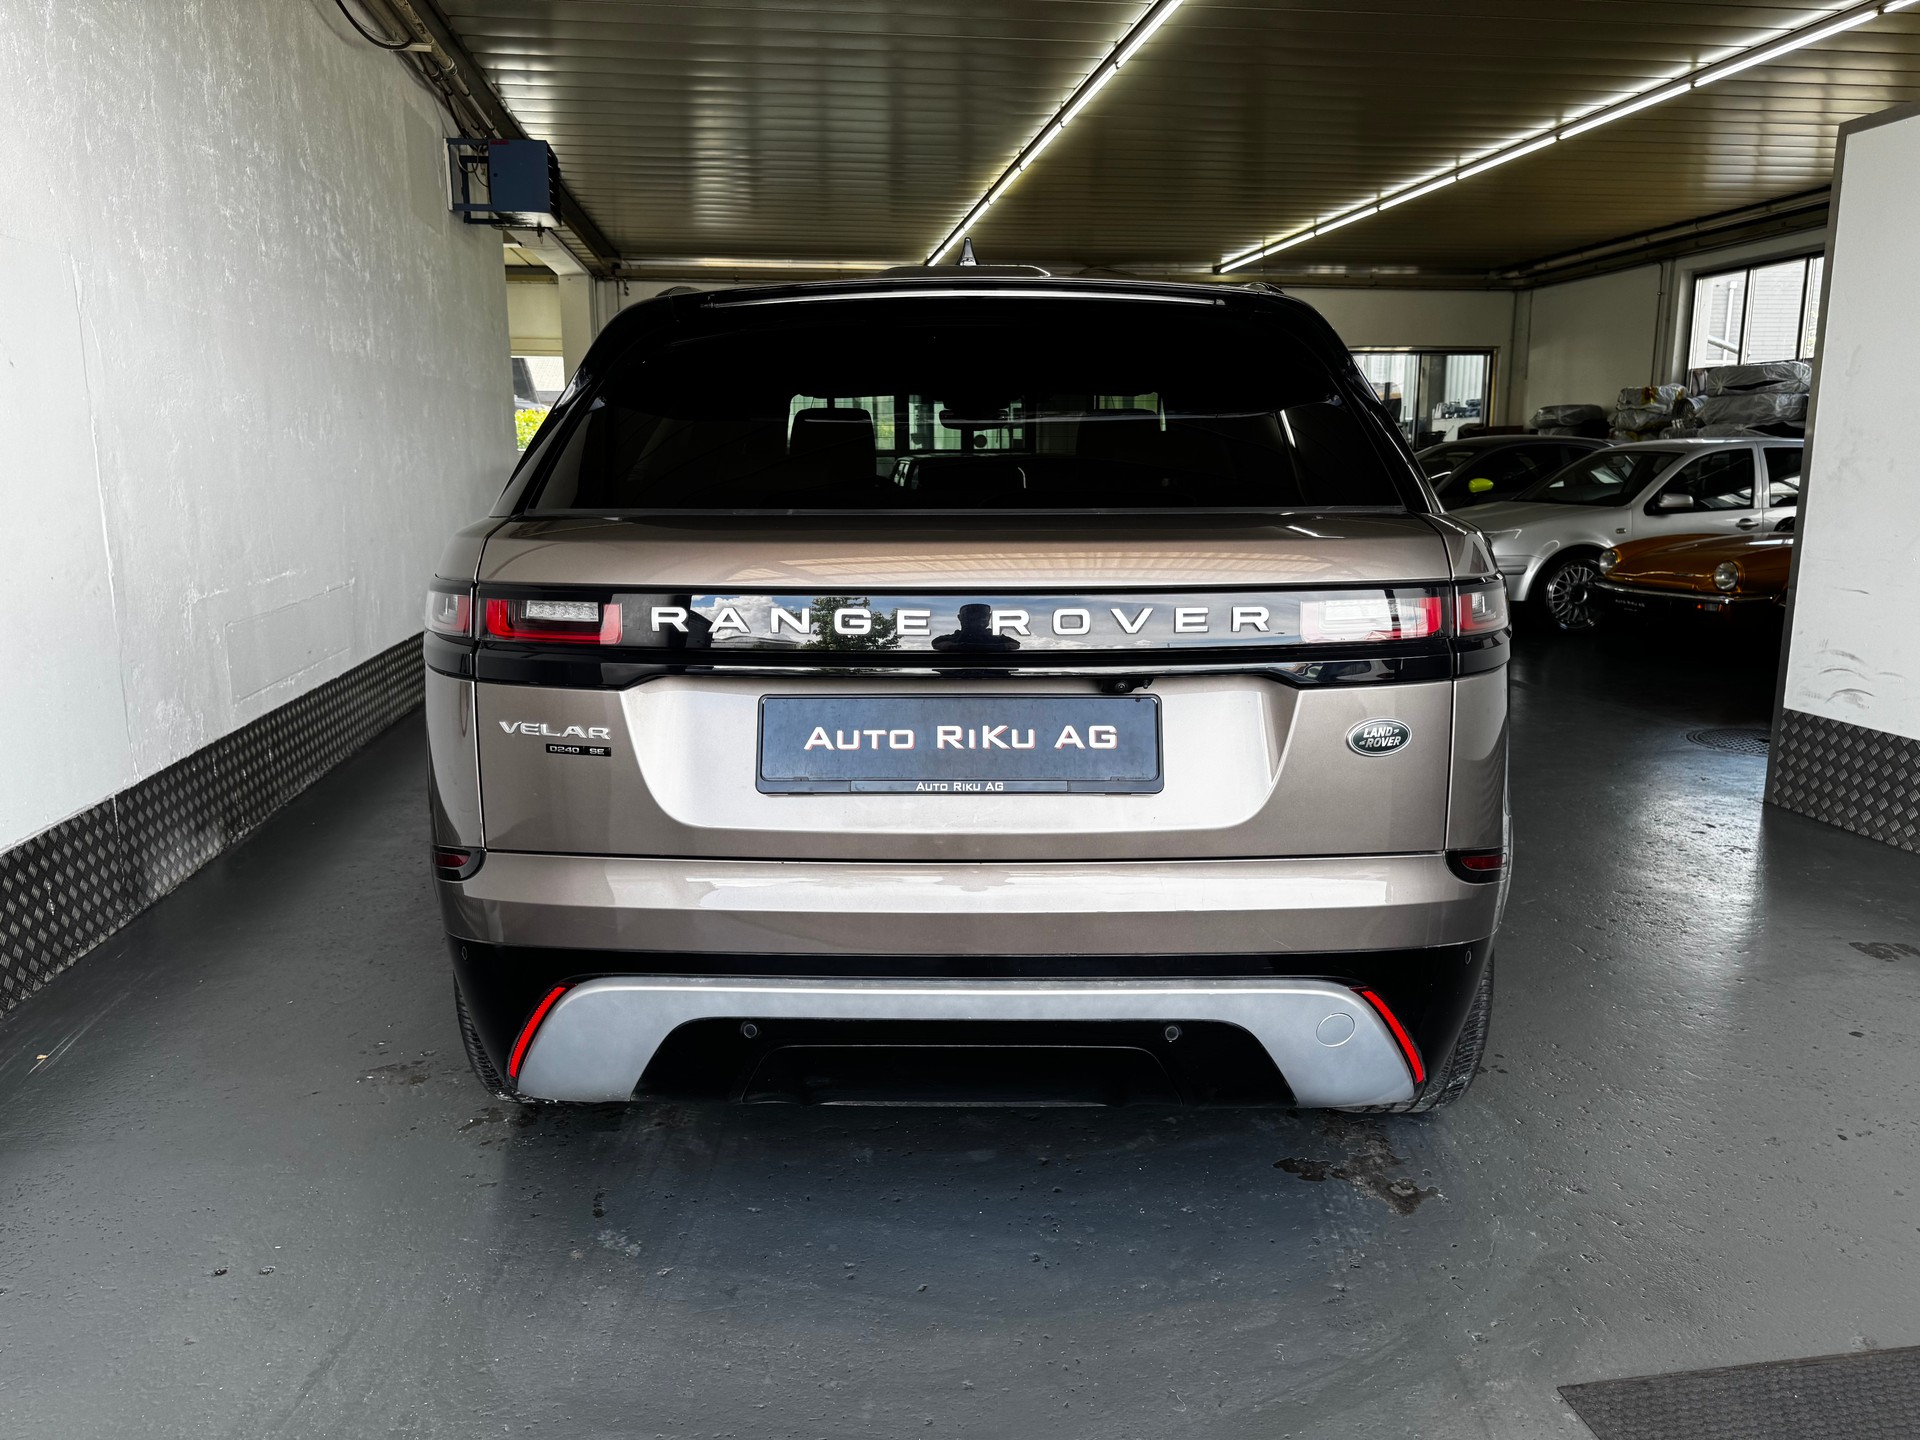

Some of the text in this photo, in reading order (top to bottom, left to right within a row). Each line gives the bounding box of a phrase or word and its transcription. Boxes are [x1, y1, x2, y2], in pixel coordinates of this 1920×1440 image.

[650, 606, 1270, 636] RANGE ROVER
[498, 721, 611, 740] VELAR
[1363, 726, 1393, 738] LAND
[1054, 725, 1117, 750] AG
[1365, 736, 1402, 748] ROVER
[549, 745, 580, 754] D240
[985, 781, 1004, 791] AG
